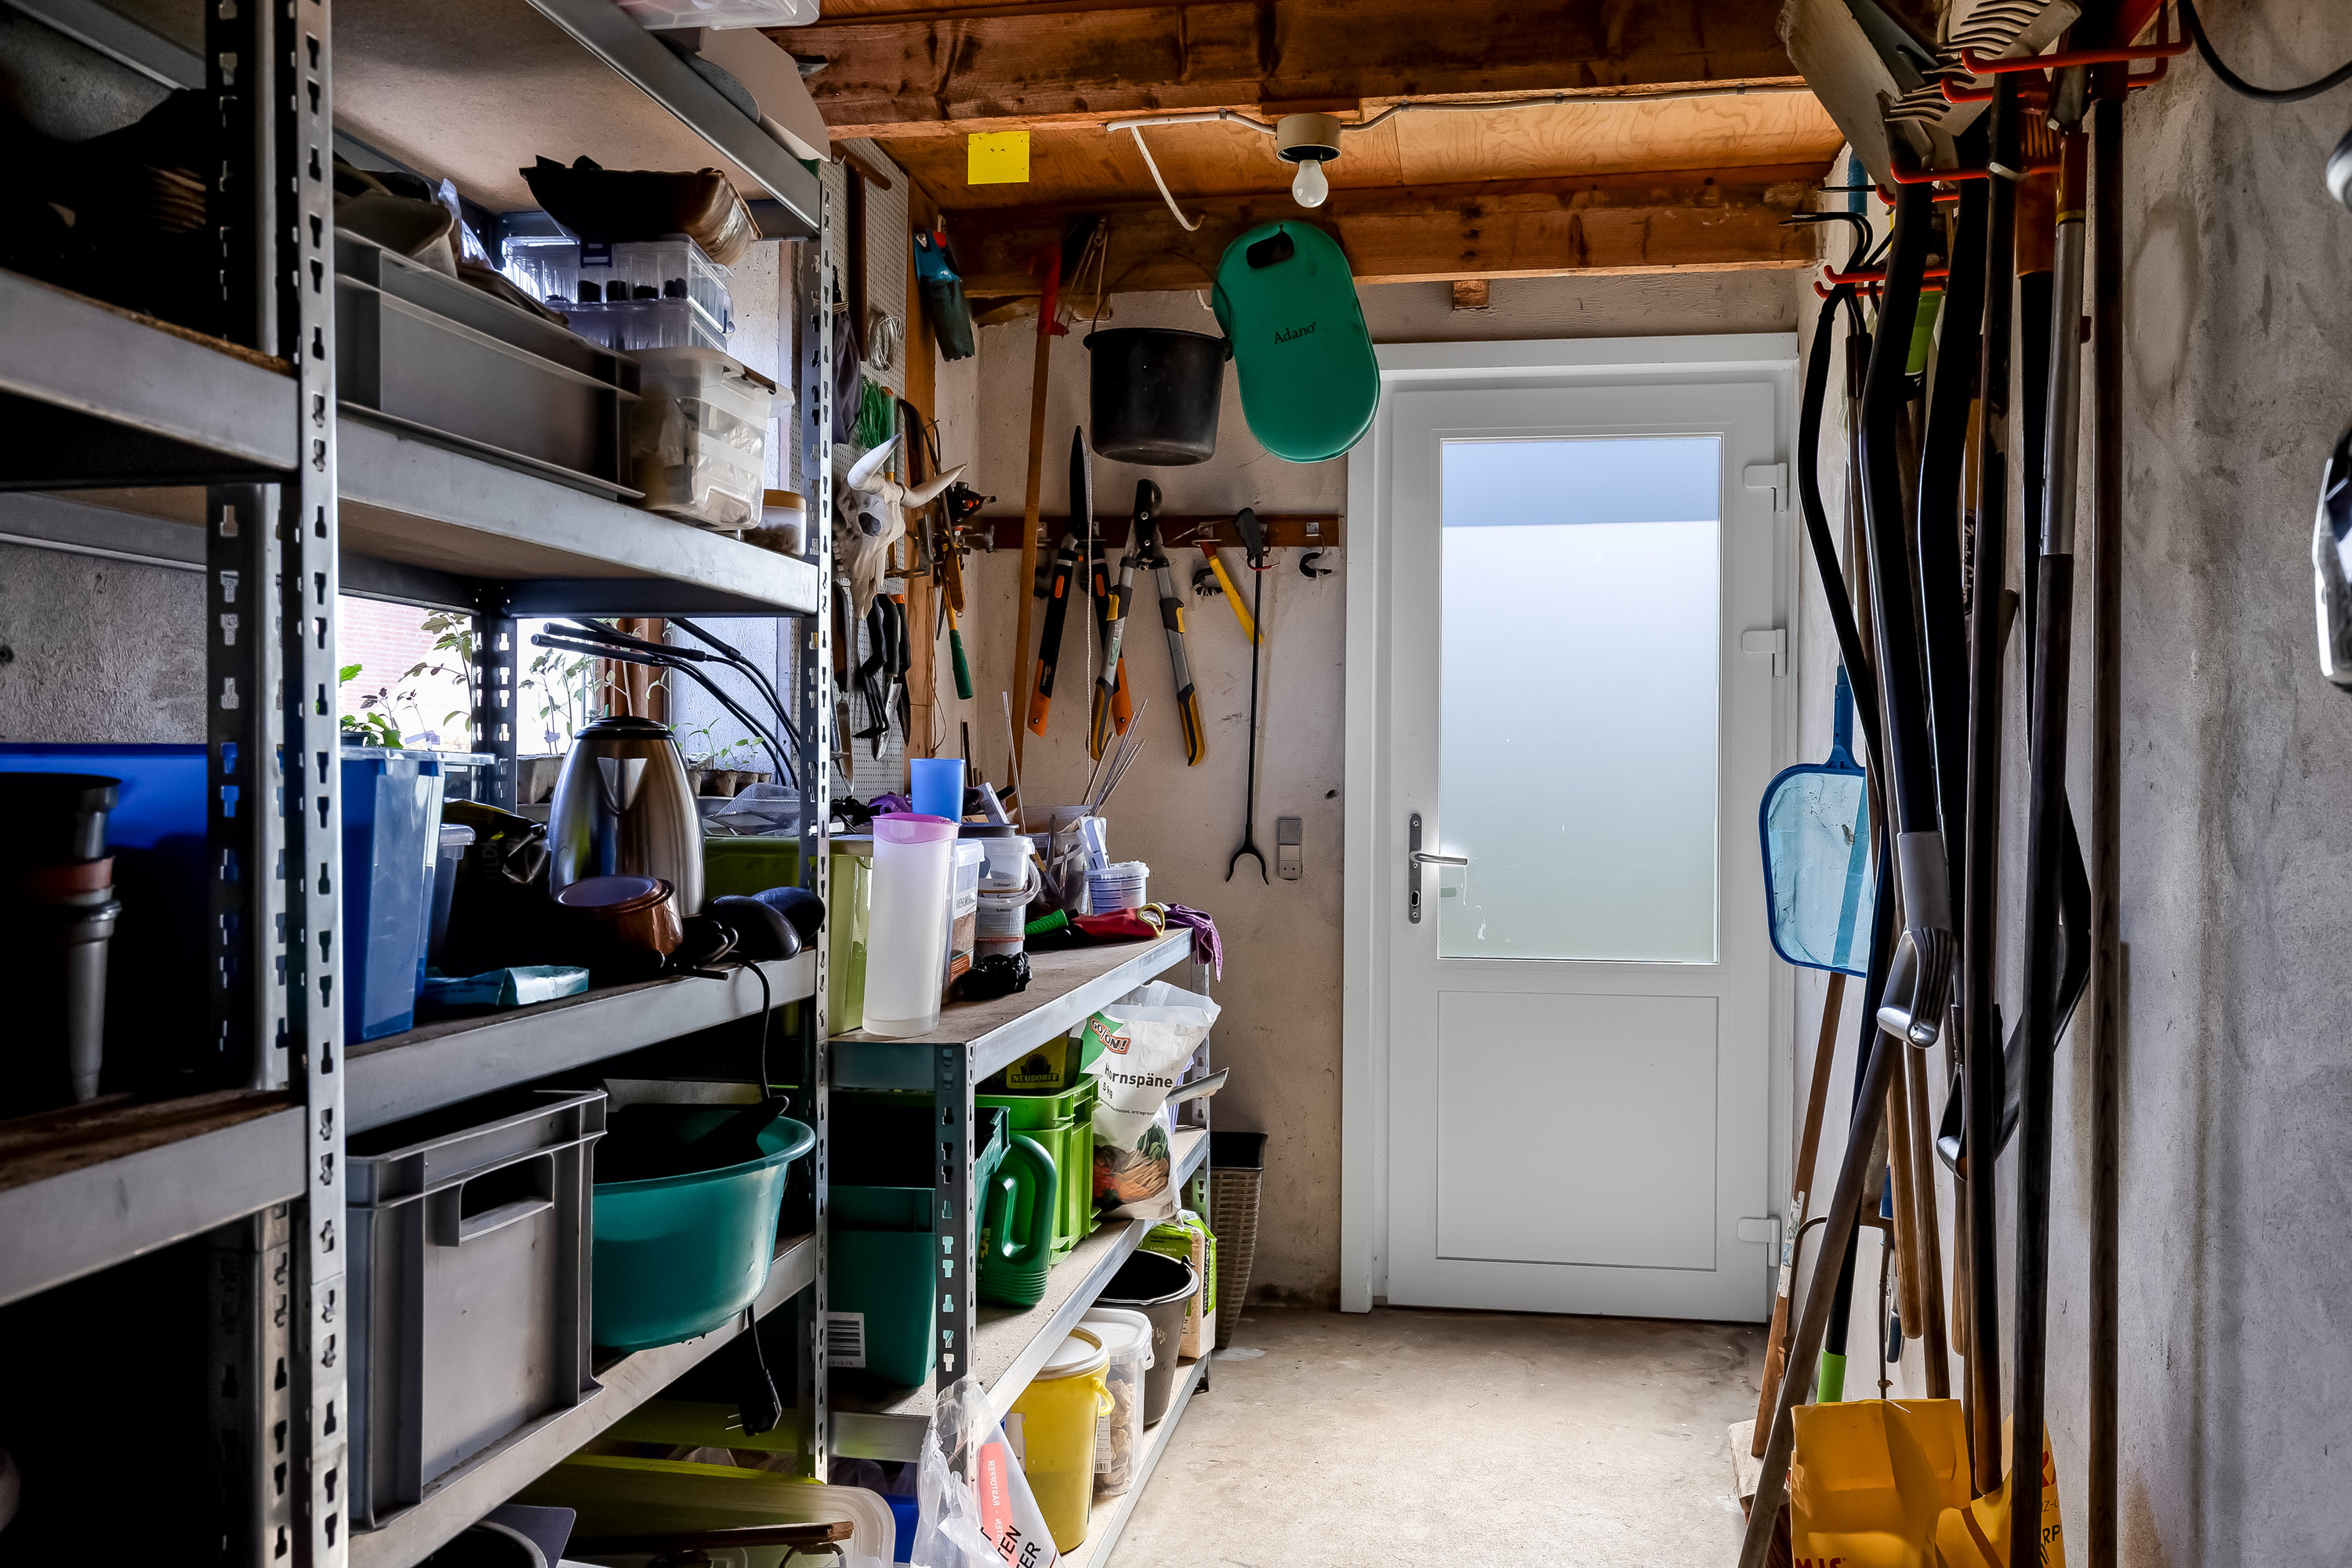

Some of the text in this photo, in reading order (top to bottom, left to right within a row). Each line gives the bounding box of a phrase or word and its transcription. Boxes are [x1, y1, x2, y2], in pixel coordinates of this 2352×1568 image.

[1105, 1062, 1173, 1088] Hornspäne
[1102, 1082, 1107, 1091] 5
[1107, 1086, 1113, 1099] kg
